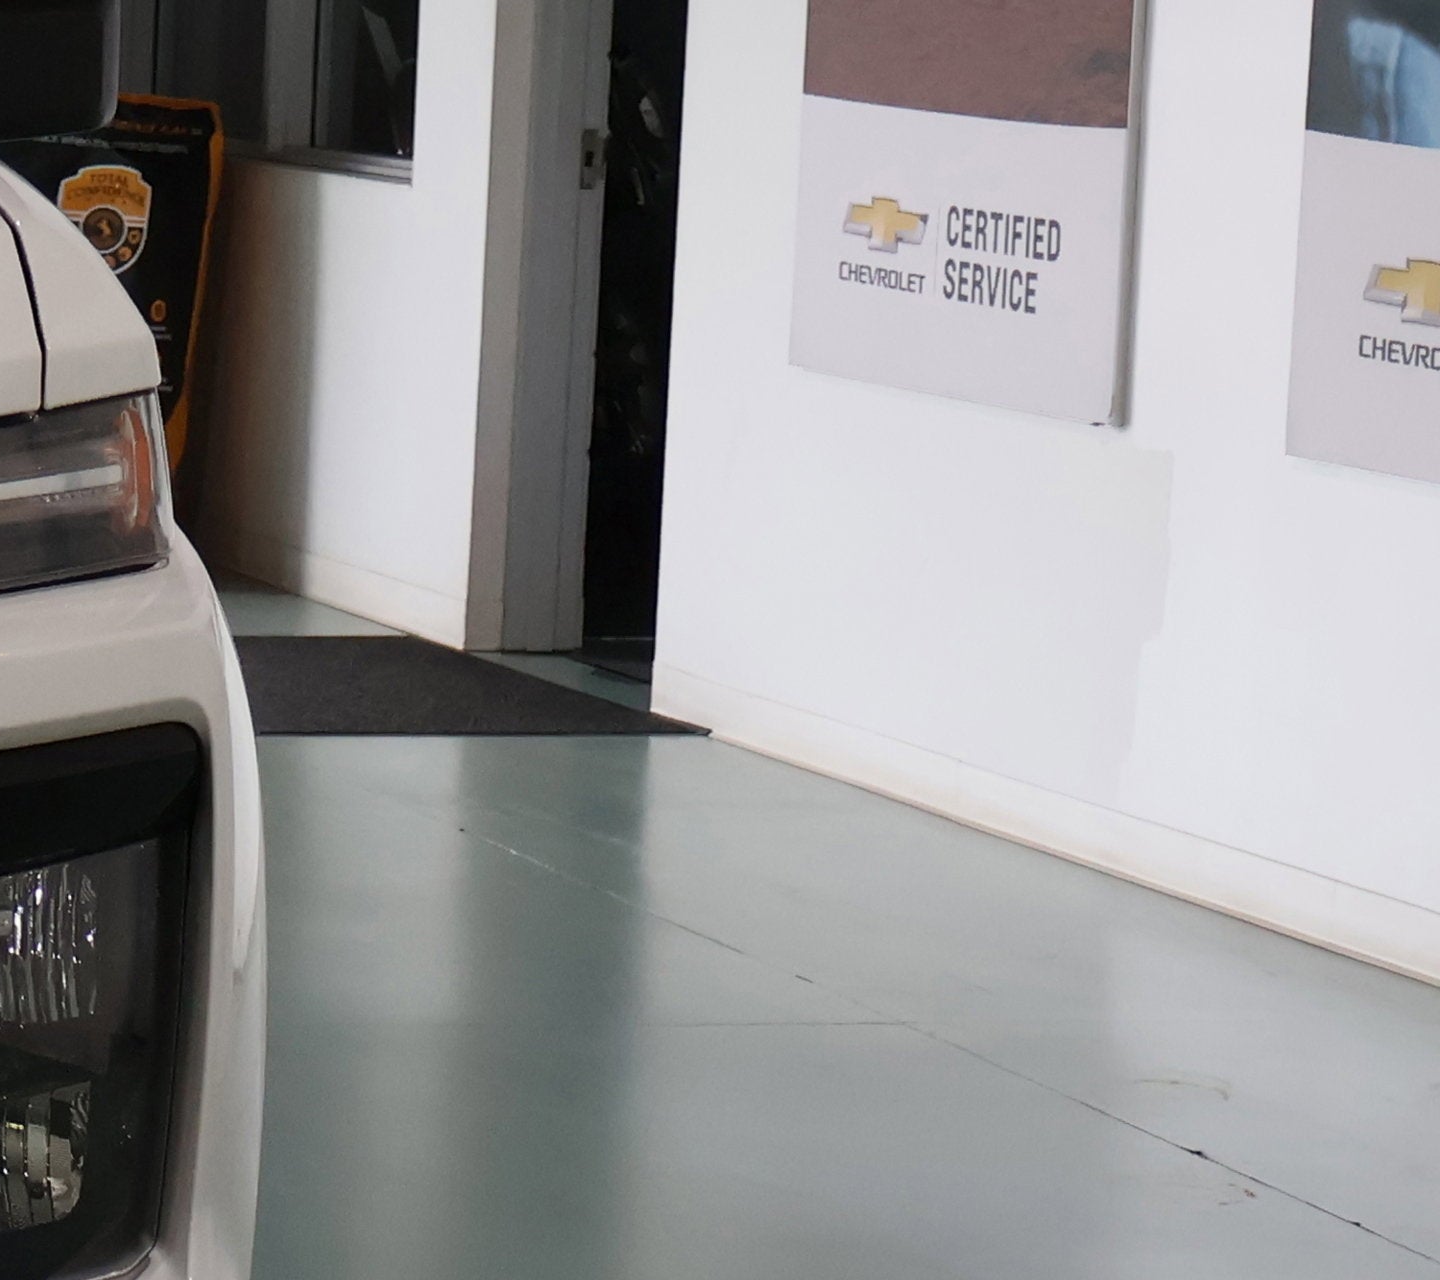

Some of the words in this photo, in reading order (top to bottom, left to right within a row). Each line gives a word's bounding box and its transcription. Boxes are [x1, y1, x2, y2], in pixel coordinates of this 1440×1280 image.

[946, 205, 1061, 262] CERTIFIED
[838, 260, 926, 295] CHEVROLET
[943, 258, 1039, 314] SERVICE
